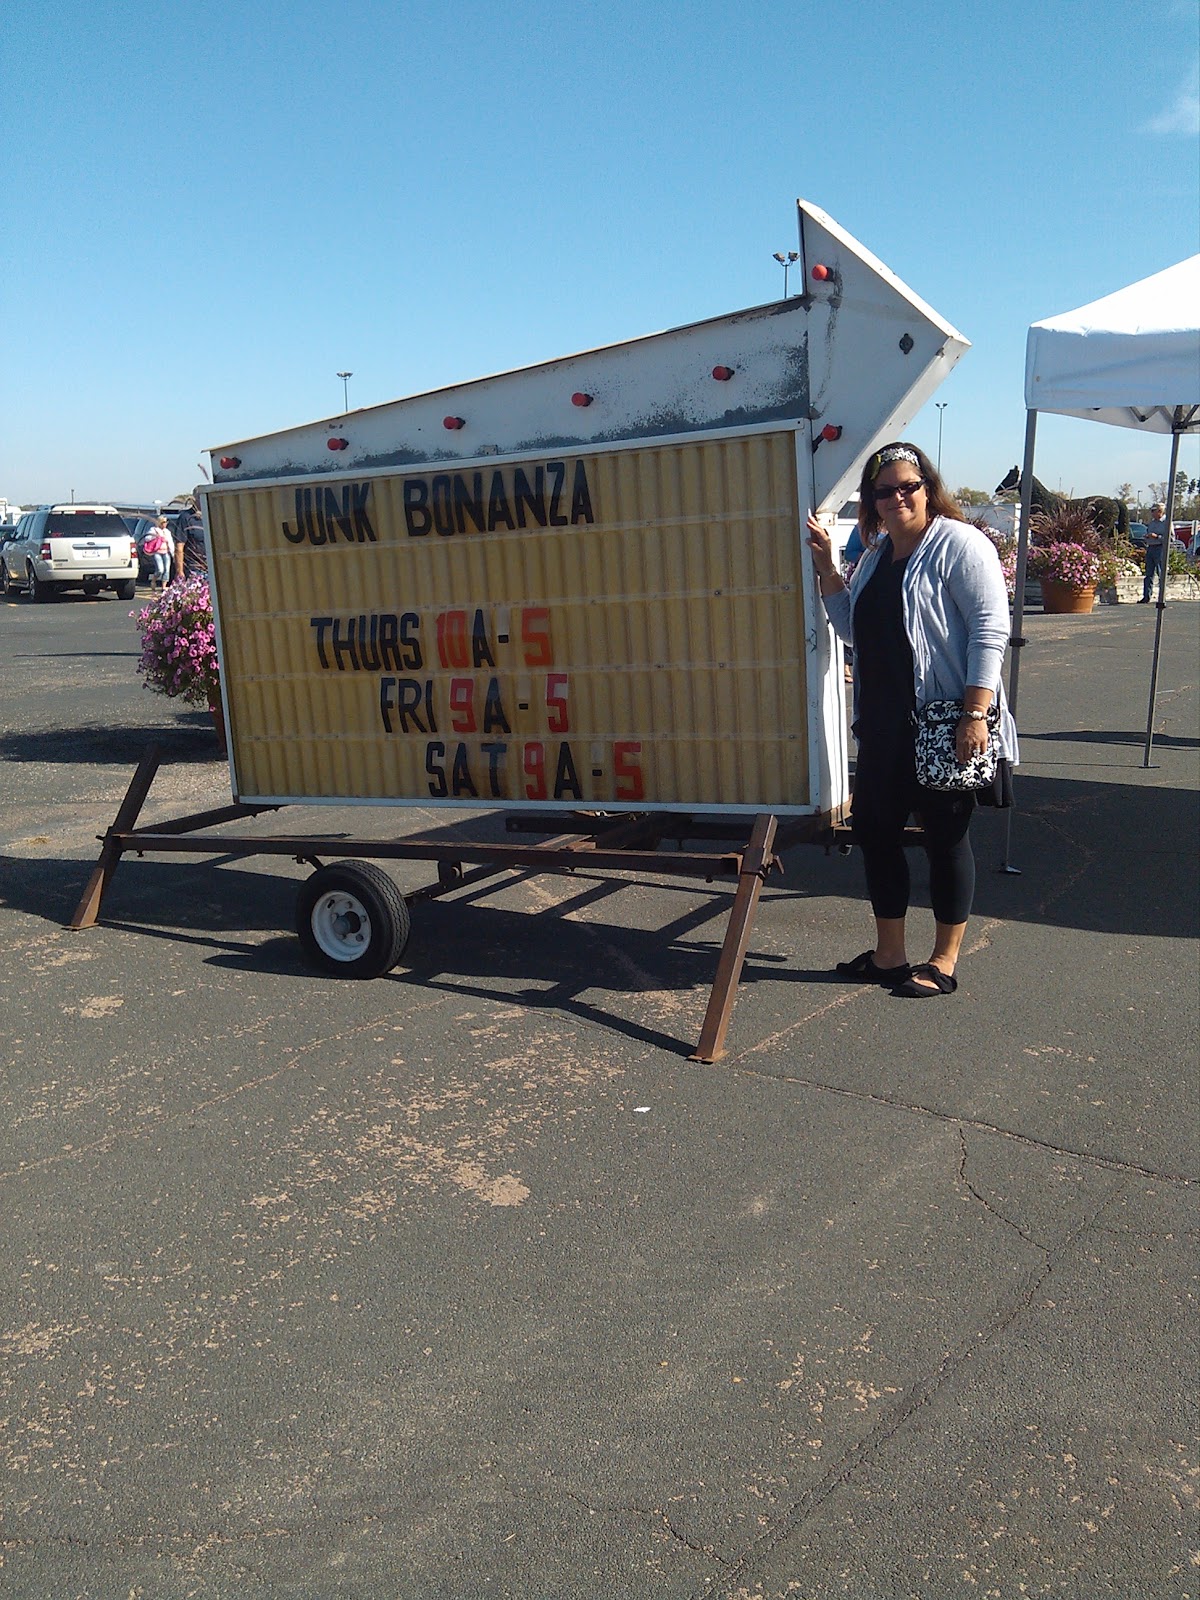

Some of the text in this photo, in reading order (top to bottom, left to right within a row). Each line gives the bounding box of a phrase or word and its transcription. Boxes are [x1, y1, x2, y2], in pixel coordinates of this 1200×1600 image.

[282, 459, 594, 546] JUNK BONANZA
[310, 612, 423, 671] THURS
[380, 676, 438, 733] FRI
[425, 741, 508, 798] SAT
